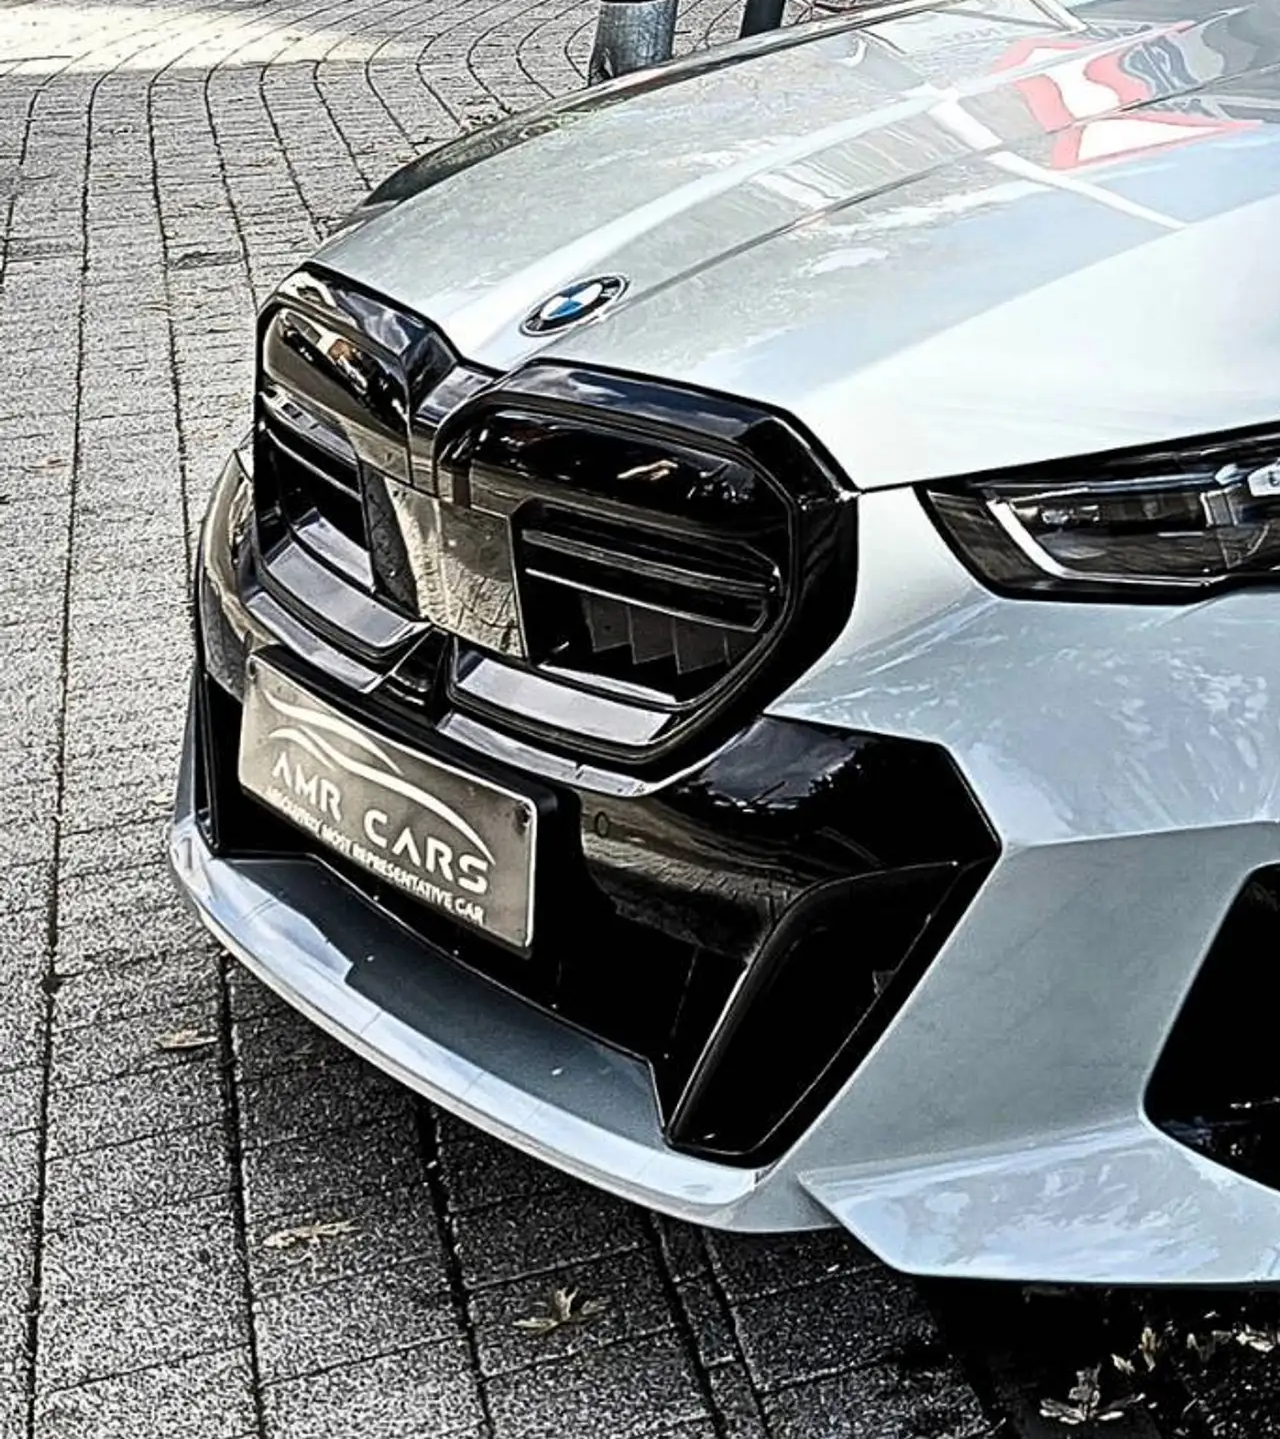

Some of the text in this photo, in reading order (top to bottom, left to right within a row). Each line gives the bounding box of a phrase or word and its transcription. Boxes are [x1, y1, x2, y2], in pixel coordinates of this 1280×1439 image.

[272, 751, 489, 894] AMR CARS
[352, 840, 453, 909] REPRESENTATIVE
[455, 897, 485, 927] CAR
